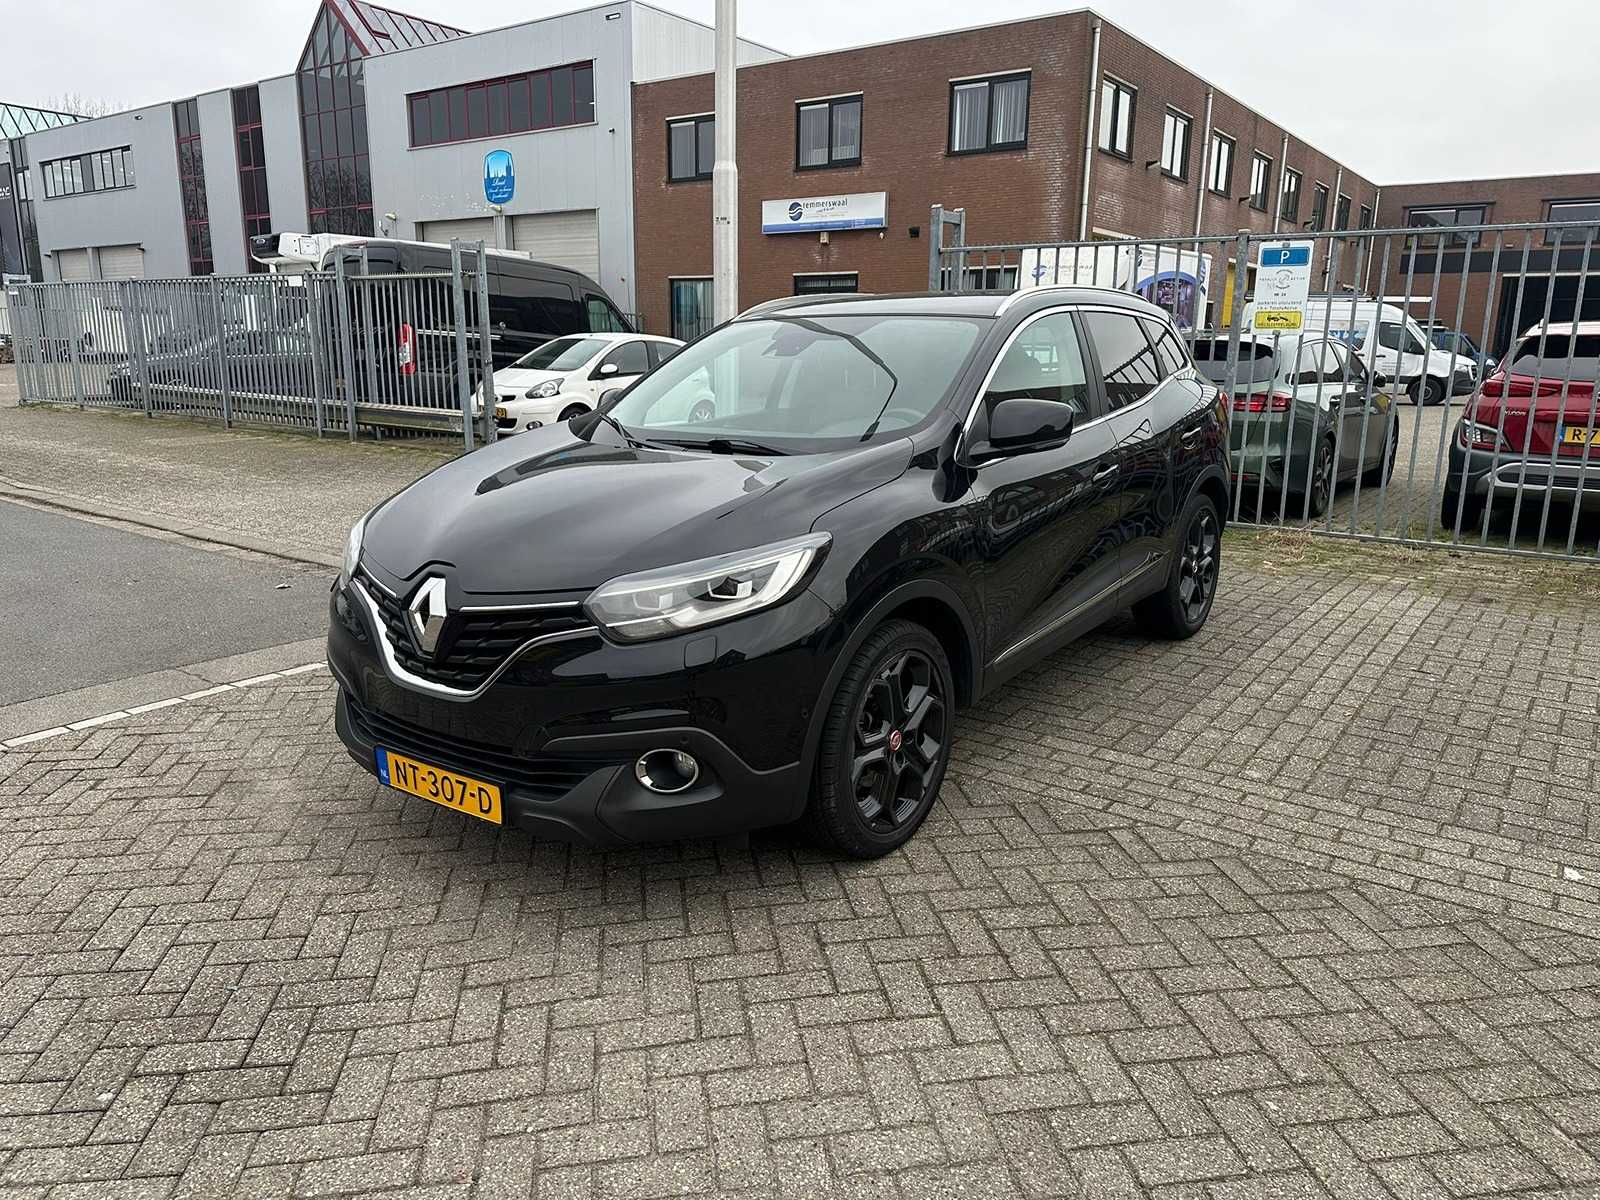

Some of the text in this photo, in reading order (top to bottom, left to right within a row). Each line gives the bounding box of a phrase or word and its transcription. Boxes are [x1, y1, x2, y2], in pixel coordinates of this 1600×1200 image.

[803, 198, 849, 209] remmerswaal
[1280, 250, 1290, 264] P
[380, 768, 389, 779] NL
[394, 759, 493, 815] NT-307-D
